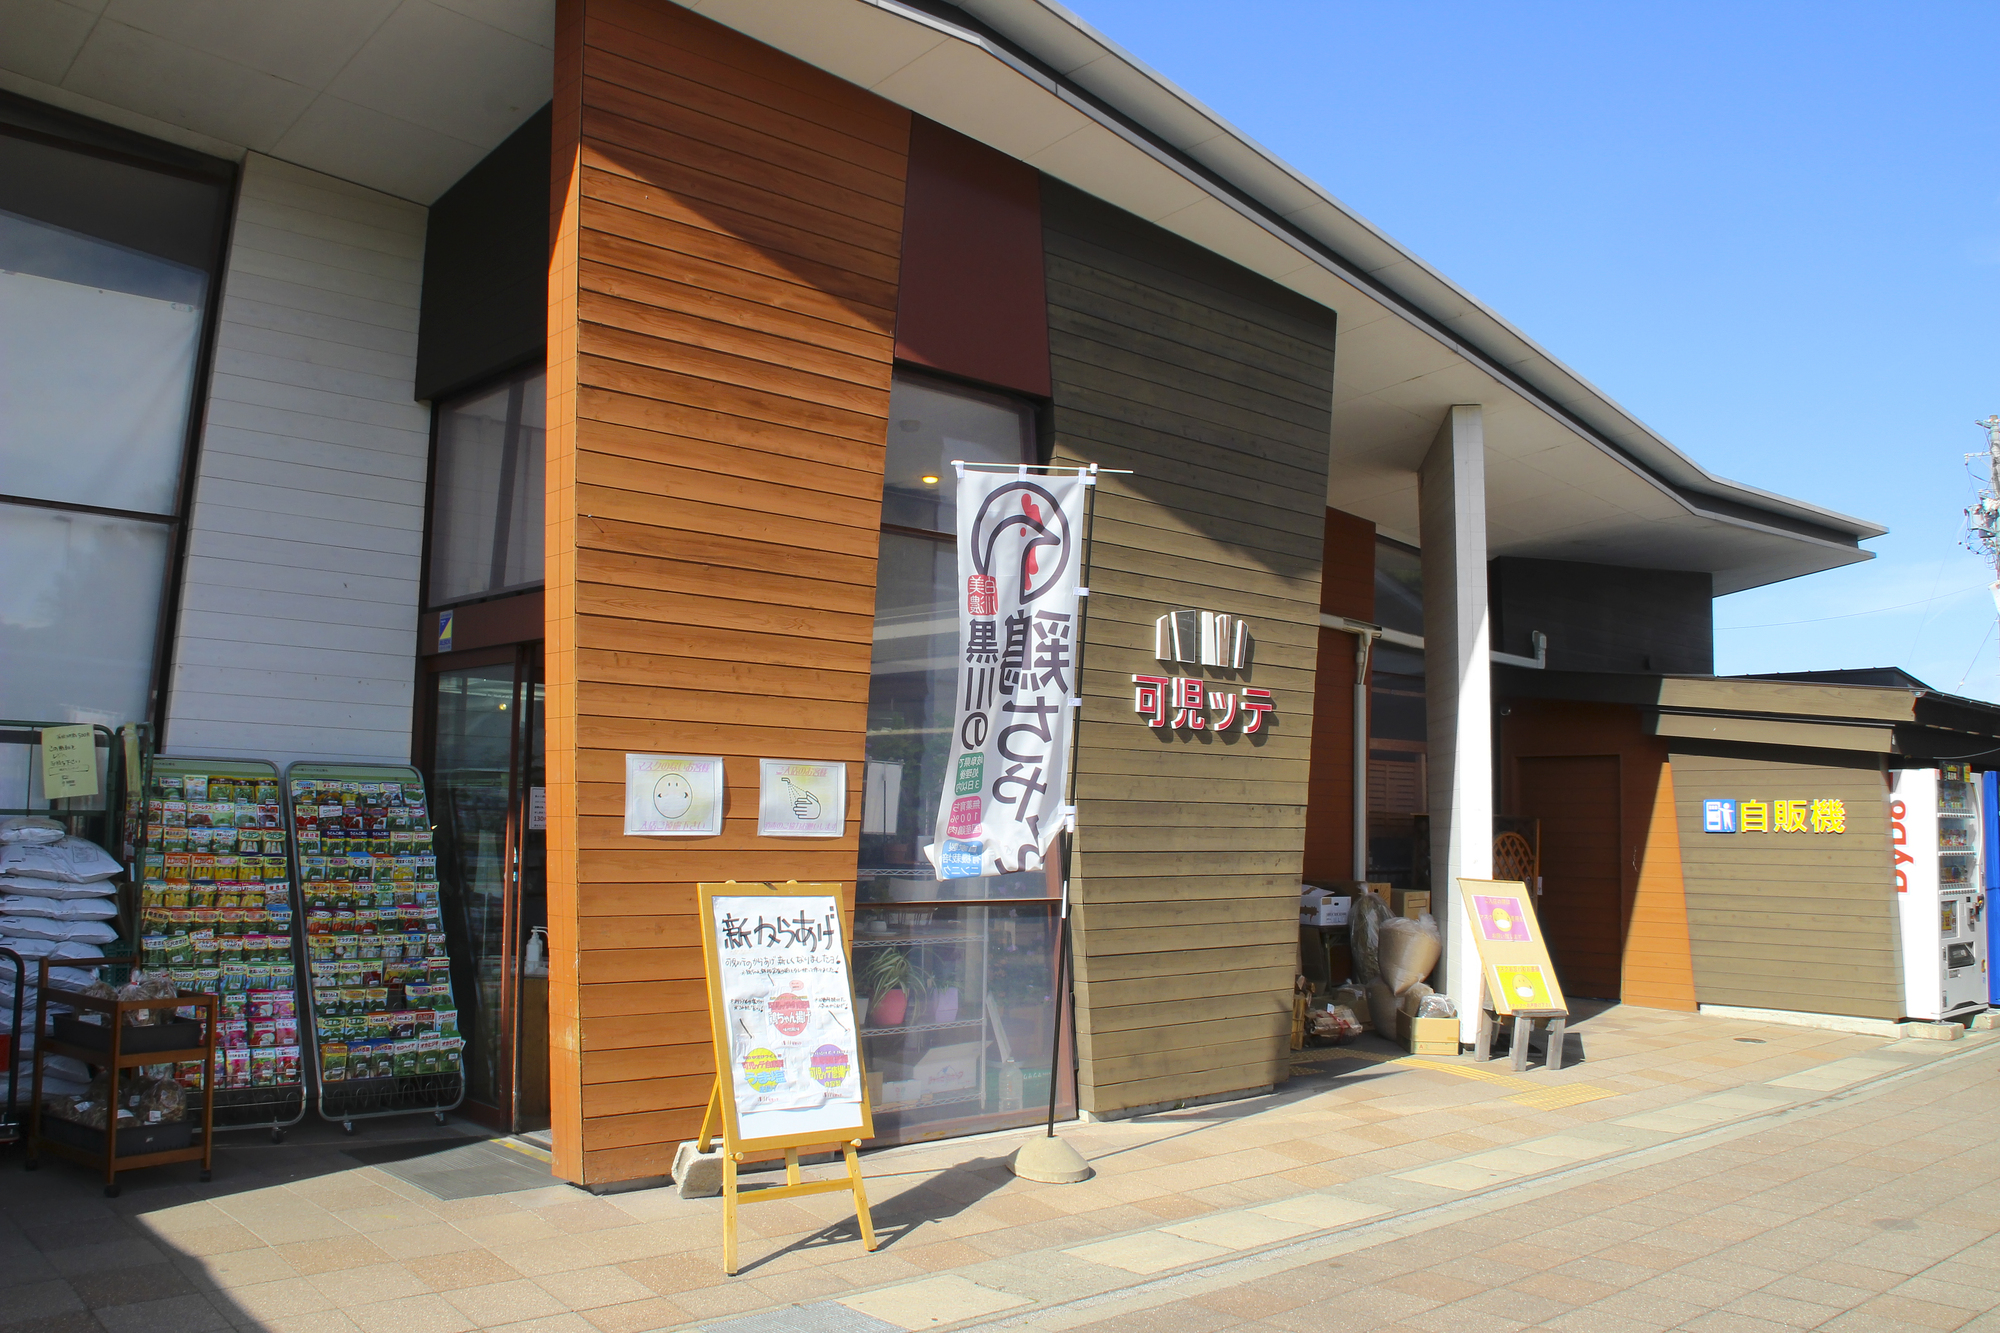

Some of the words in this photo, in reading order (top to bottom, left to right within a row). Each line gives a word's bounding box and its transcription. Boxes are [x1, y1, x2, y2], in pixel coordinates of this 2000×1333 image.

[1132, 674, 1272, 734] 可児ッテ
[1740, 799, 1846, 834] 自販機
[722, 906, 835, 952] 新からあげ
